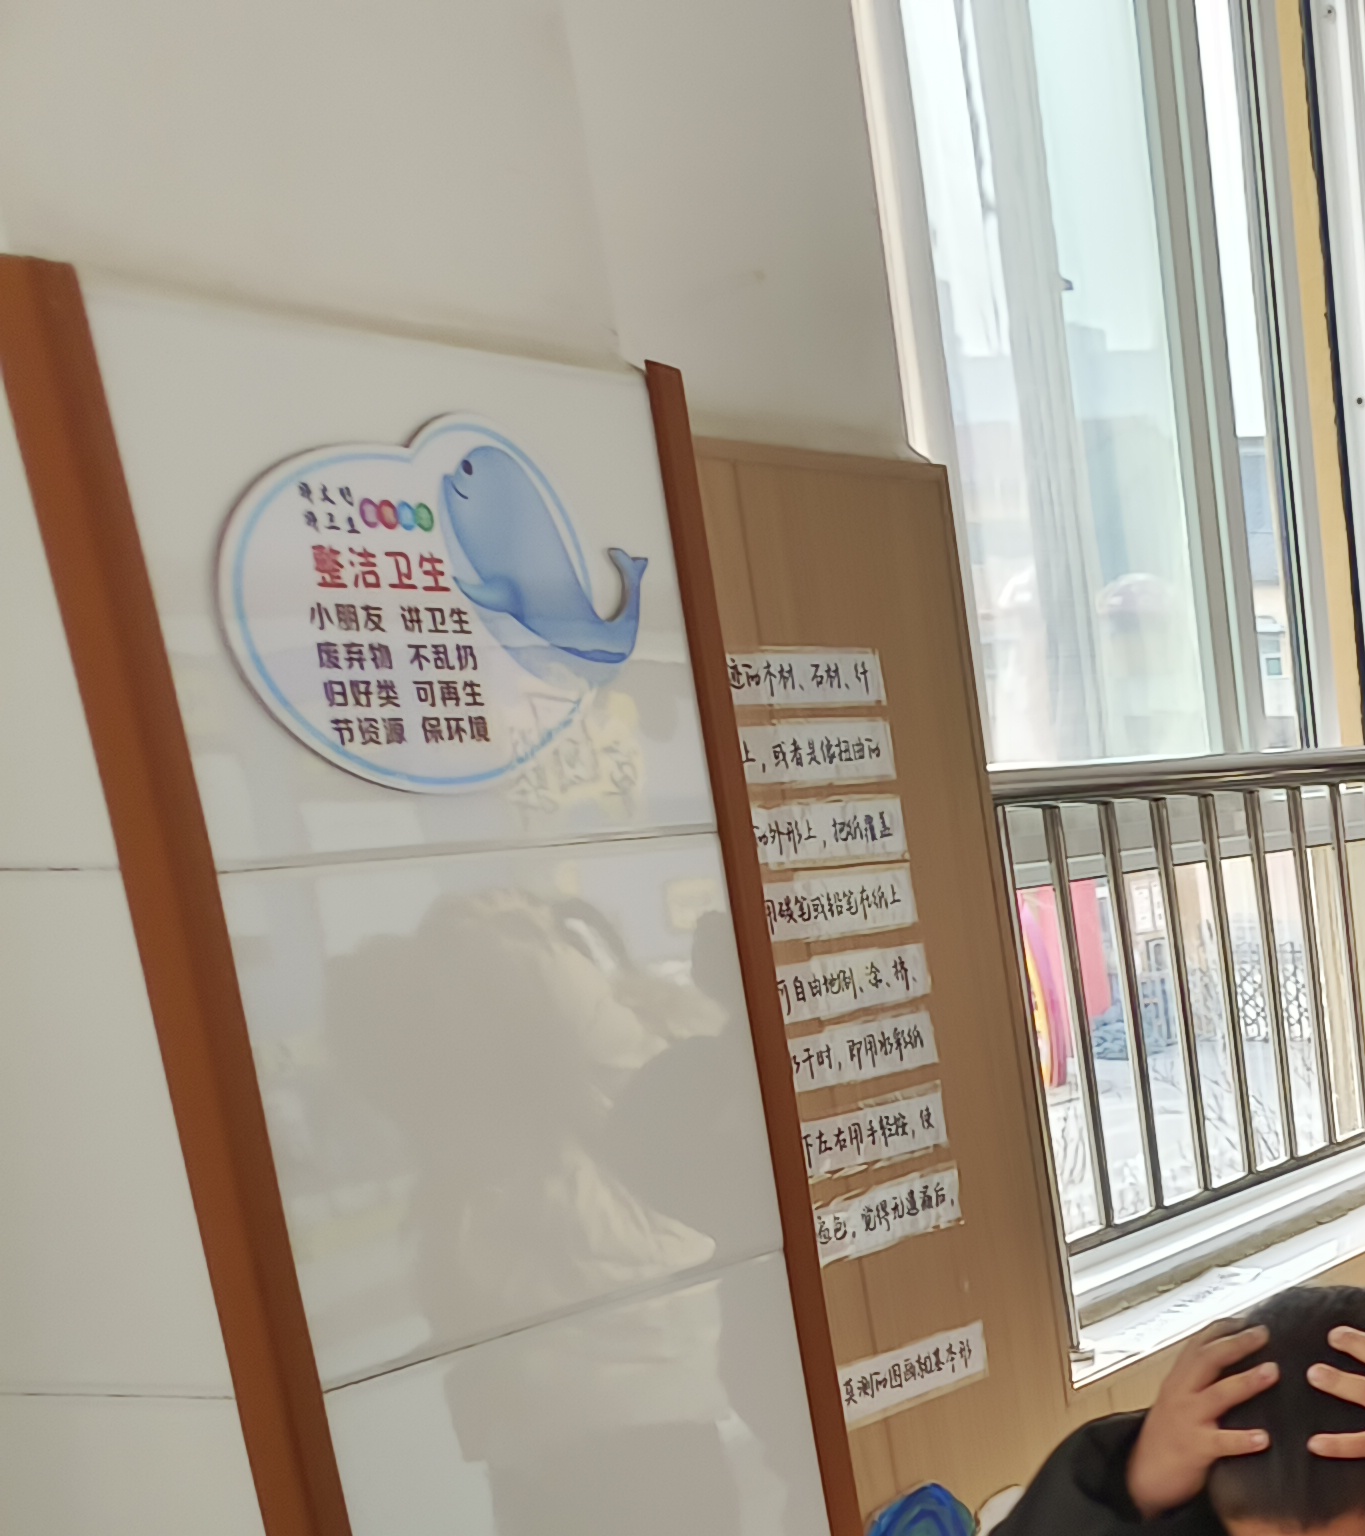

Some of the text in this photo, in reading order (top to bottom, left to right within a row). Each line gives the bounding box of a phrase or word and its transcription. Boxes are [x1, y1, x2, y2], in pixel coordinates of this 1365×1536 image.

[311, 544, 451, 592] 整洁卫生
[310, 602, 473, 635] 小朋友 讲卫生
[316, 641, 393, 671] 废弃物
[323, 679, 485, 708] 归好类 可再生
[330, 714, 491, 746] 节资源 保环境
